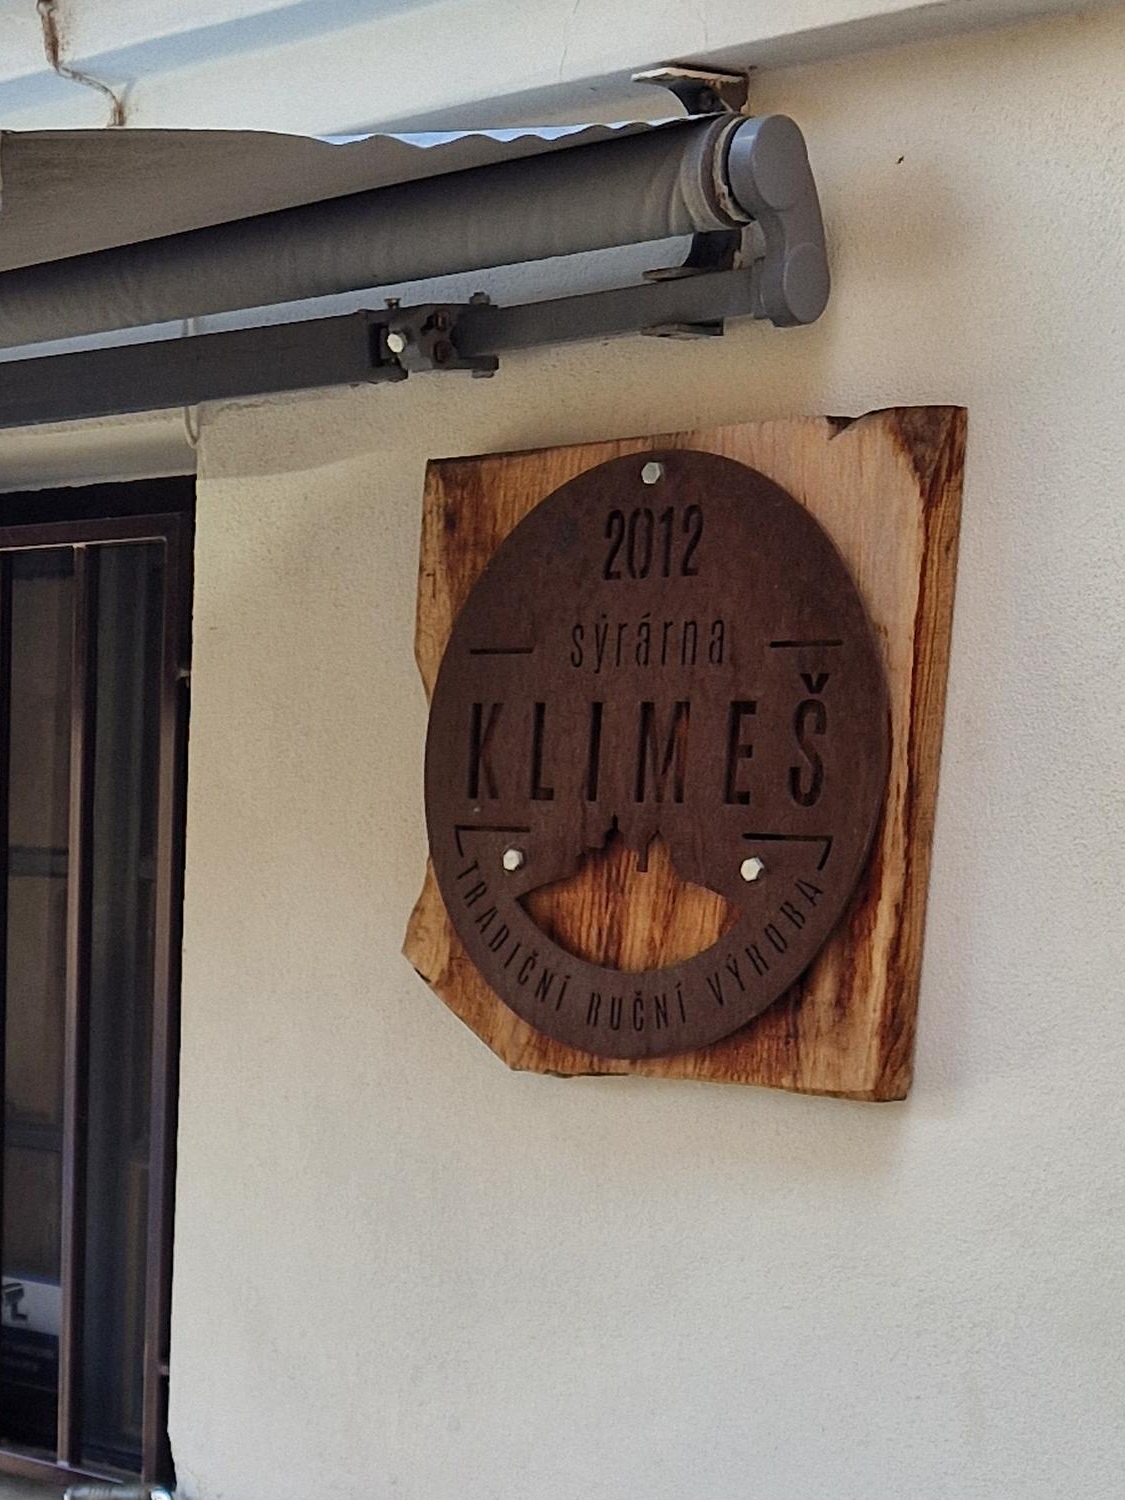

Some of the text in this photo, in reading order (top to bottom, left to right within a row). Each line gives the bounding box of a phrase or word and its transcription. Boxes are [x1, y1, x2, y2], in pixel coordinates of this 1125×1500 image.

[603, 504, 704, 581] 2012
[570, 612, 725, 674] sýrárna
[467, 672, 831, 807] KLIMEŠ
[456, 860, 825, 1033] TRADIČNÍ RUČNÍ VÝROBA
